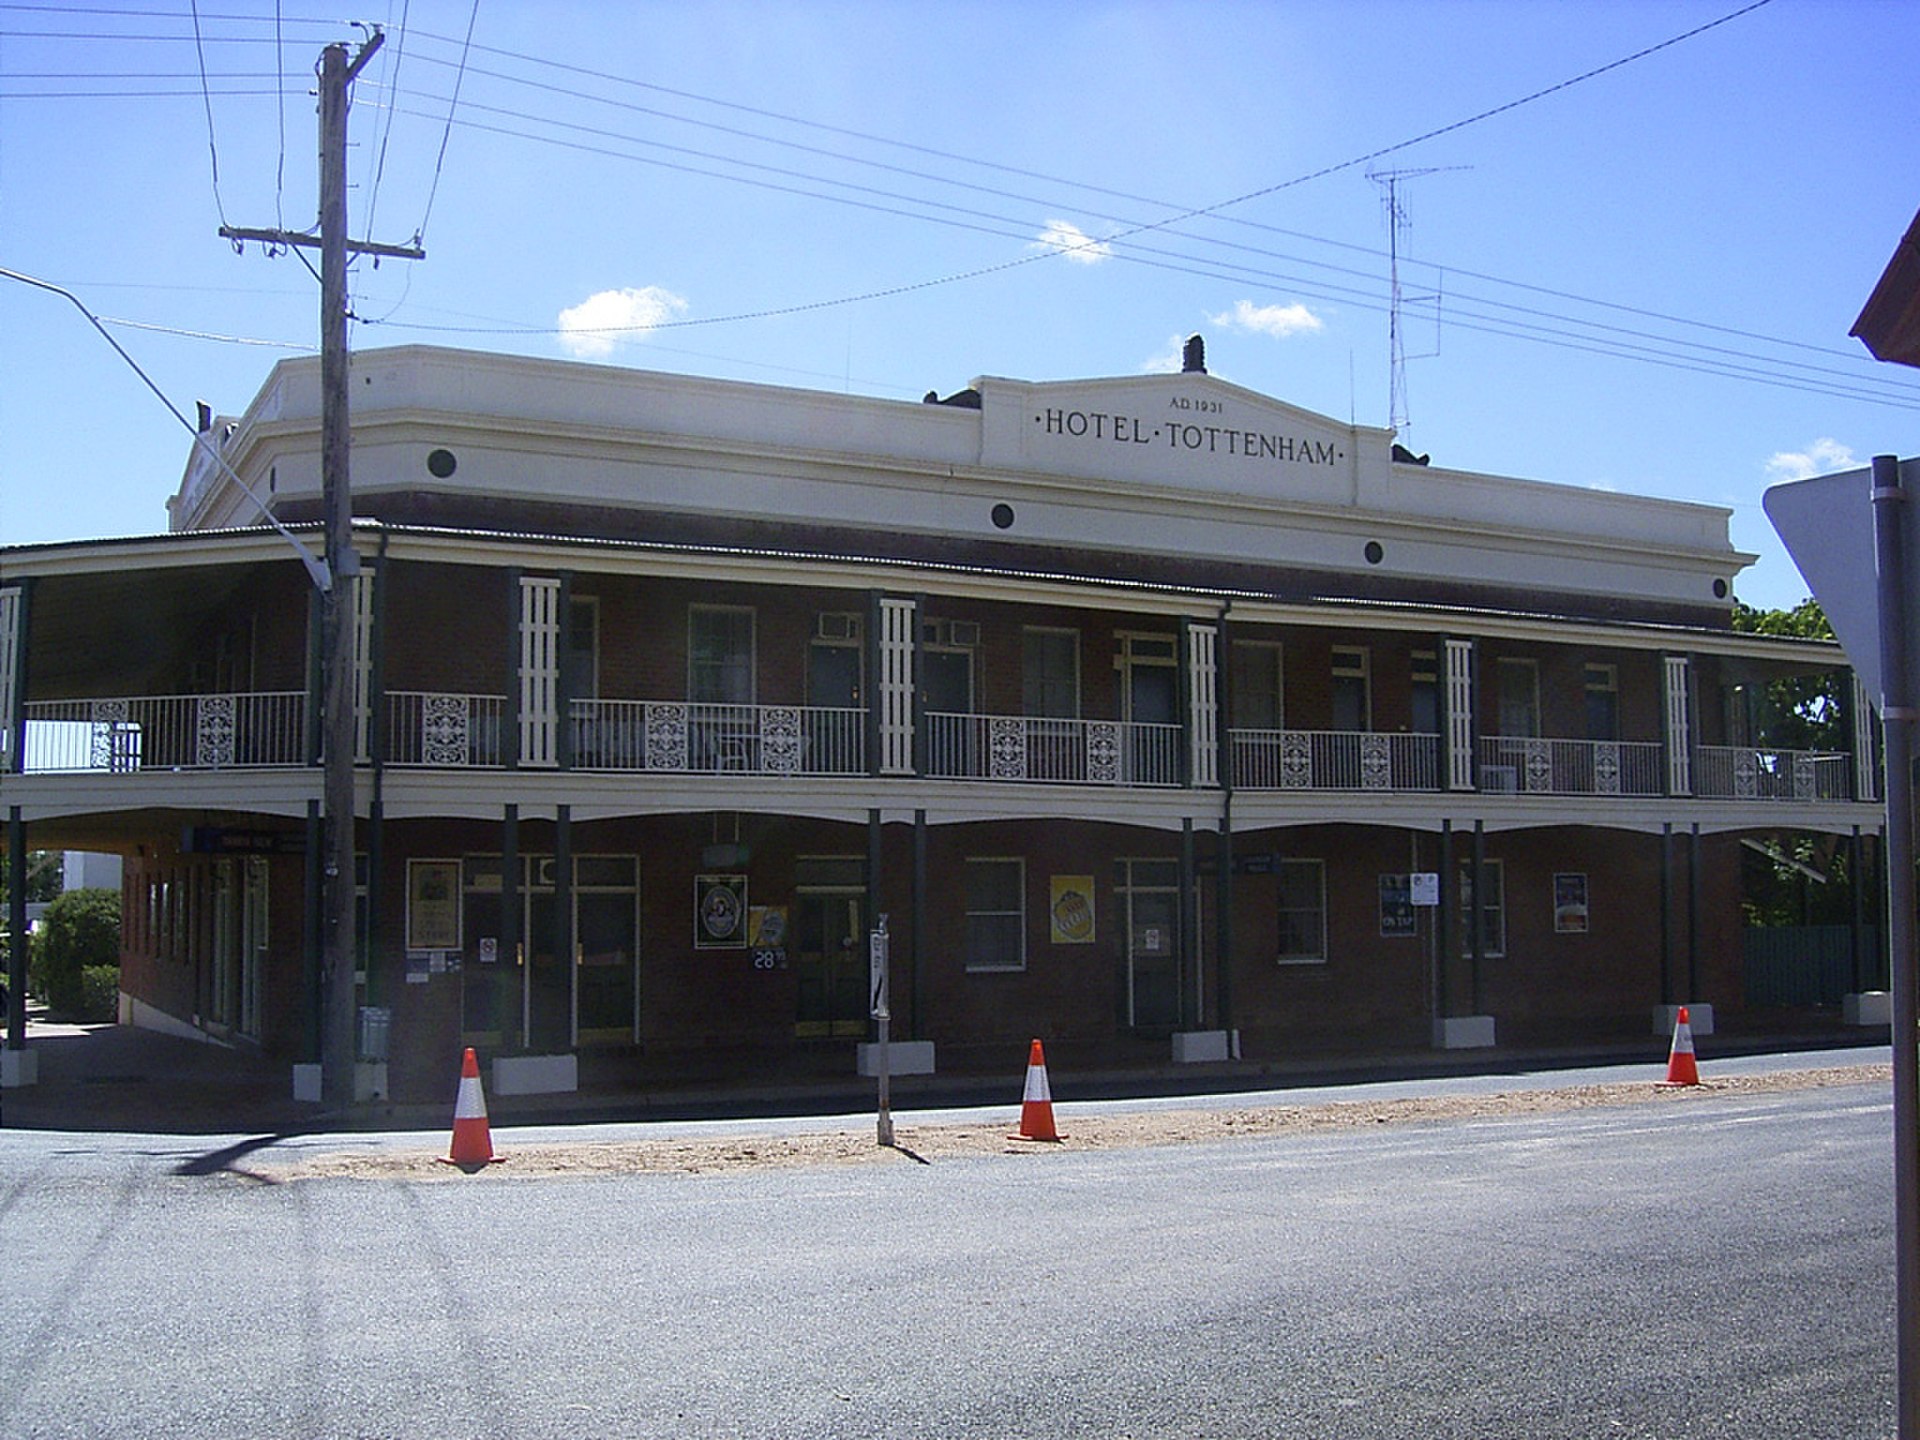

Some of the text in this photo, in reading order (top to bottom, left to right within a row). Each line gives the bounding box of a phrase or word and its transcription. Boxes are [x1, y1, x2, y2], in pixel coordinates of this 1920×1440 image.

[1195, 399, 1222, 414] 1931
[1044, 408, 1335, 466] HOTEL TOTTENHAM
[754, 951, 774, 969] 28
